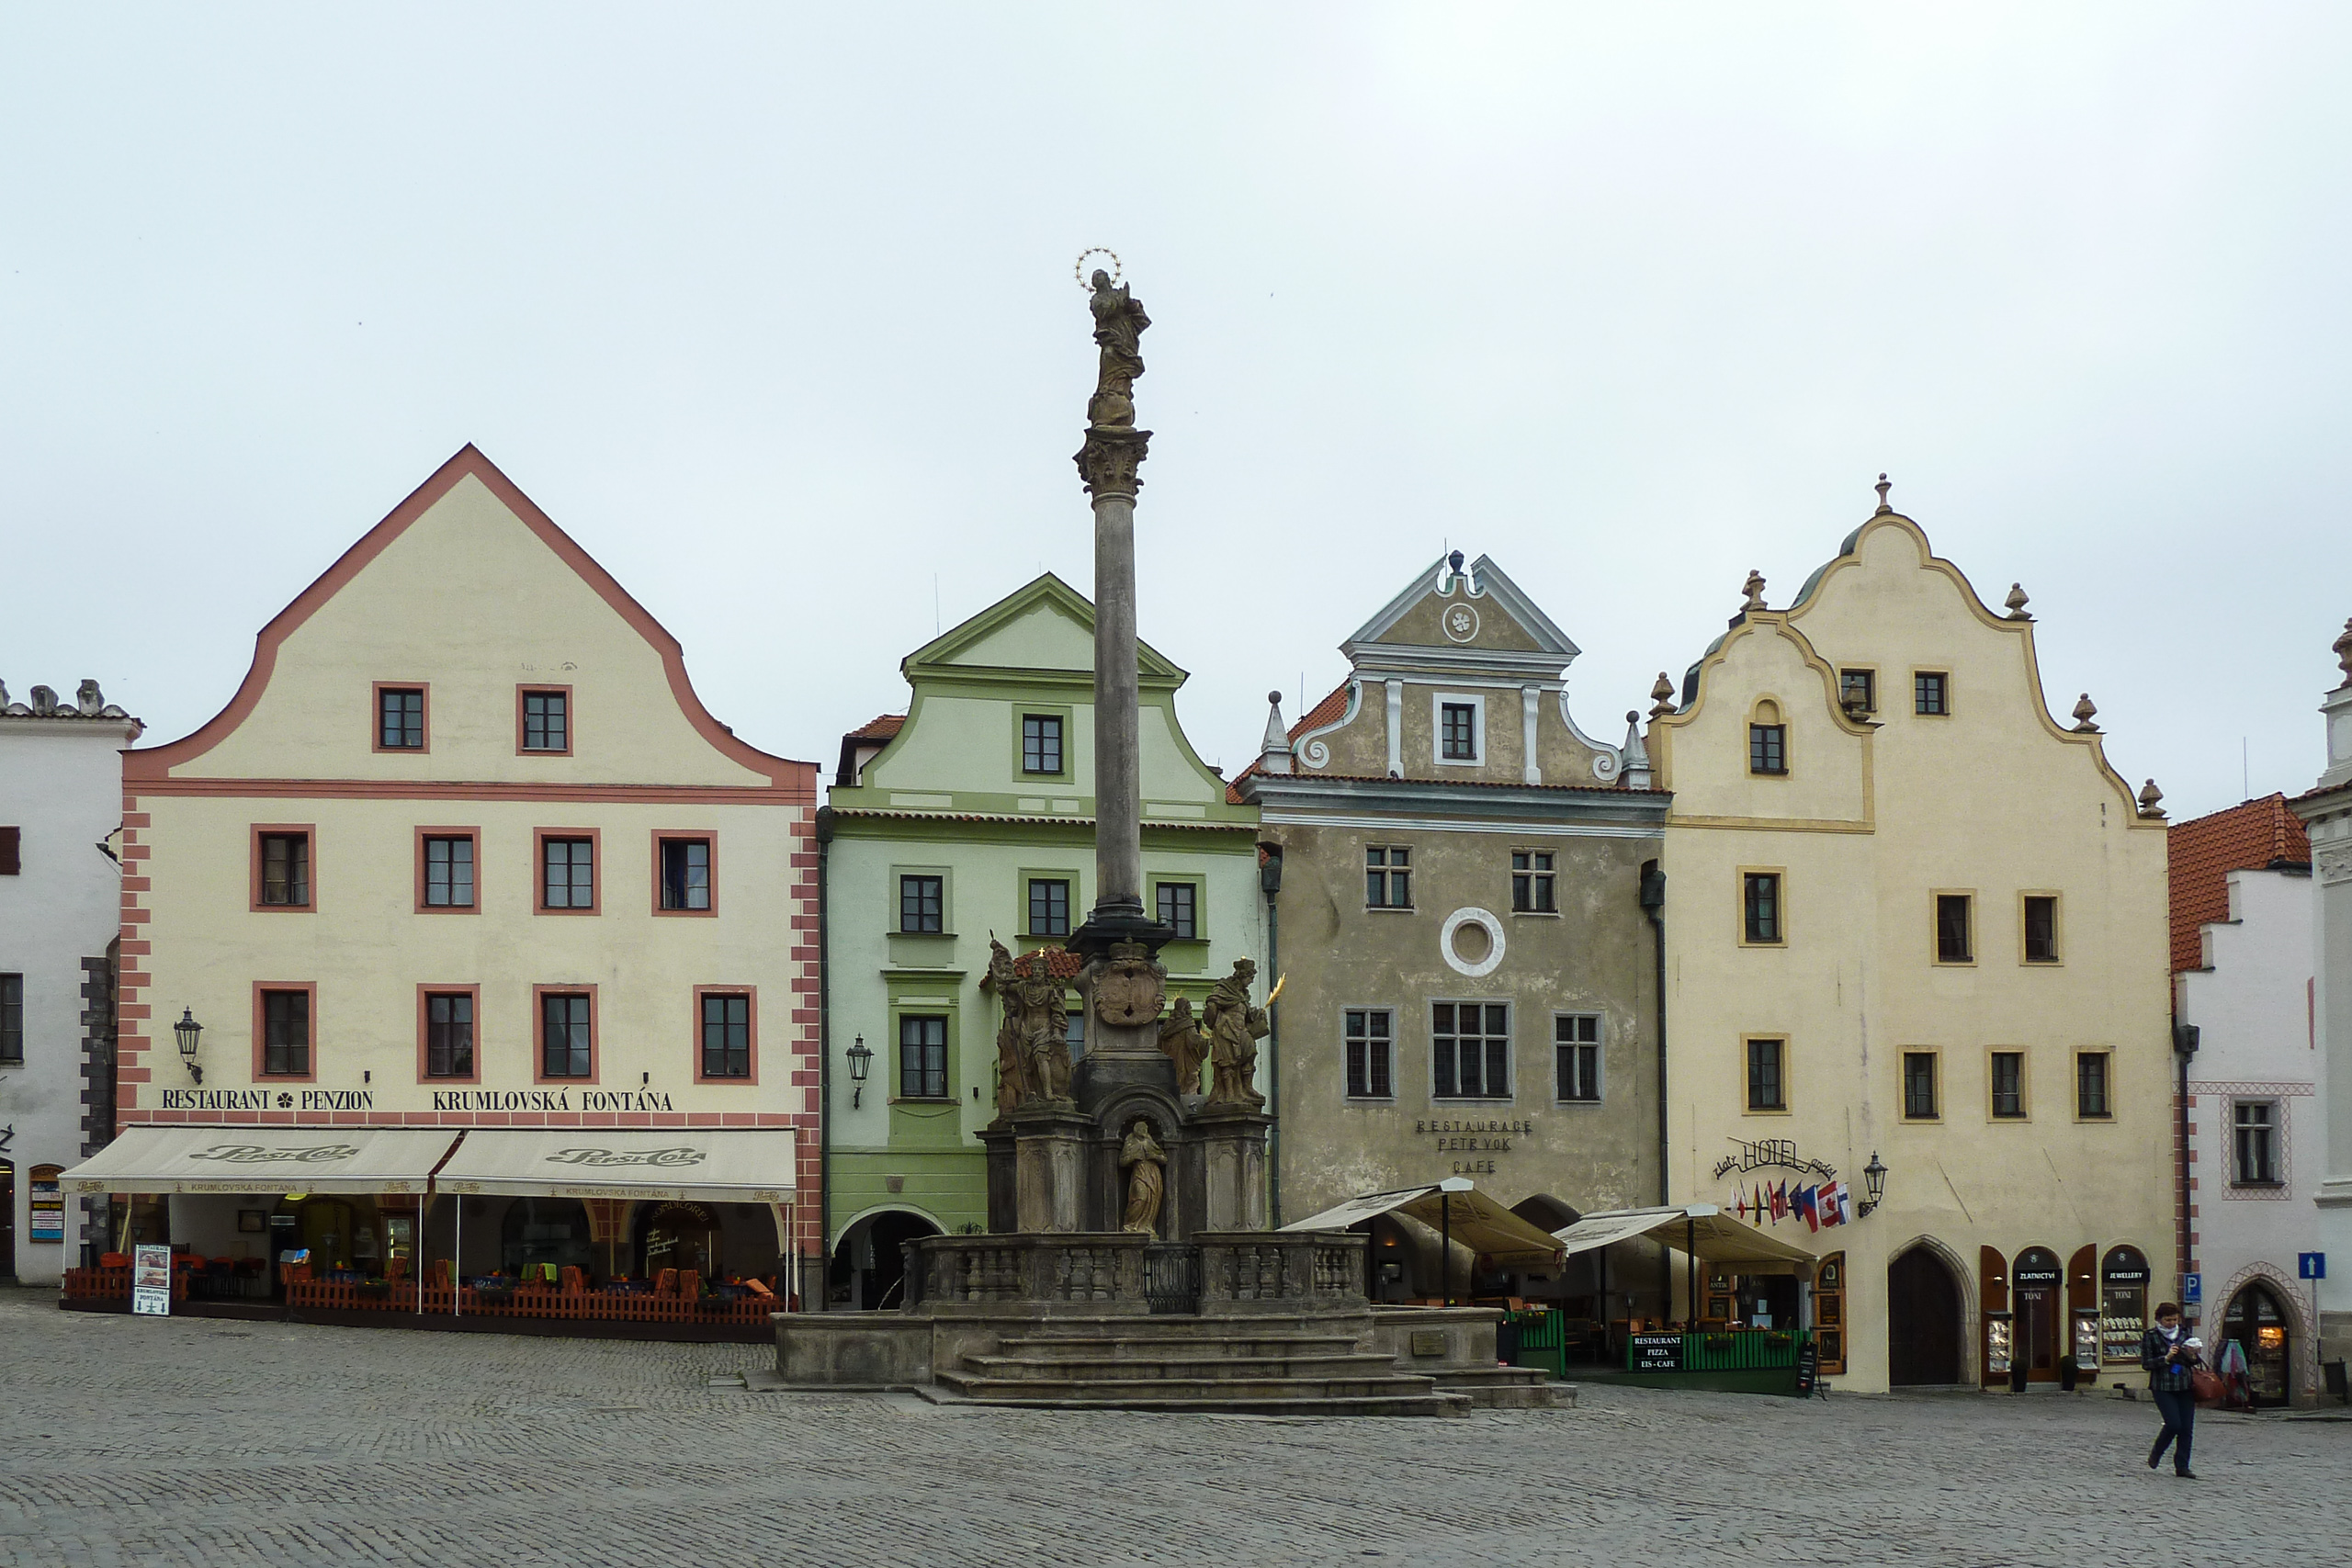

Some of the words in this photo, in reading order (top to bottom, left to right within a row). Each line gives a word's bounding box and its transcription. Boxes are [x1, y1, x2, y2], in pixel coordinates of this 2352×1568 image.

[162, 1089, 271, 1110] RESTAURANT
[300, 1090, 374, 1111] PENZION
[432, 1086, 571, 1111] KRUMLOVSKÁ
[582, 1086, 673, 1112] FONTÁNA
[1416, 1120, 1532, 1134] RESTAURACE
[1438, 1138, 1477, 1151] PETR
[1484, 1138, 1511, 1151] VOK
[1743, 1138, 1804, 1171] HOTEL
[1453, 1160, 1496, 1174] CAFE
[2188, 1277, 2198, 1293] P
[1634, 1337, 1681, 1345] RESTAURANT
